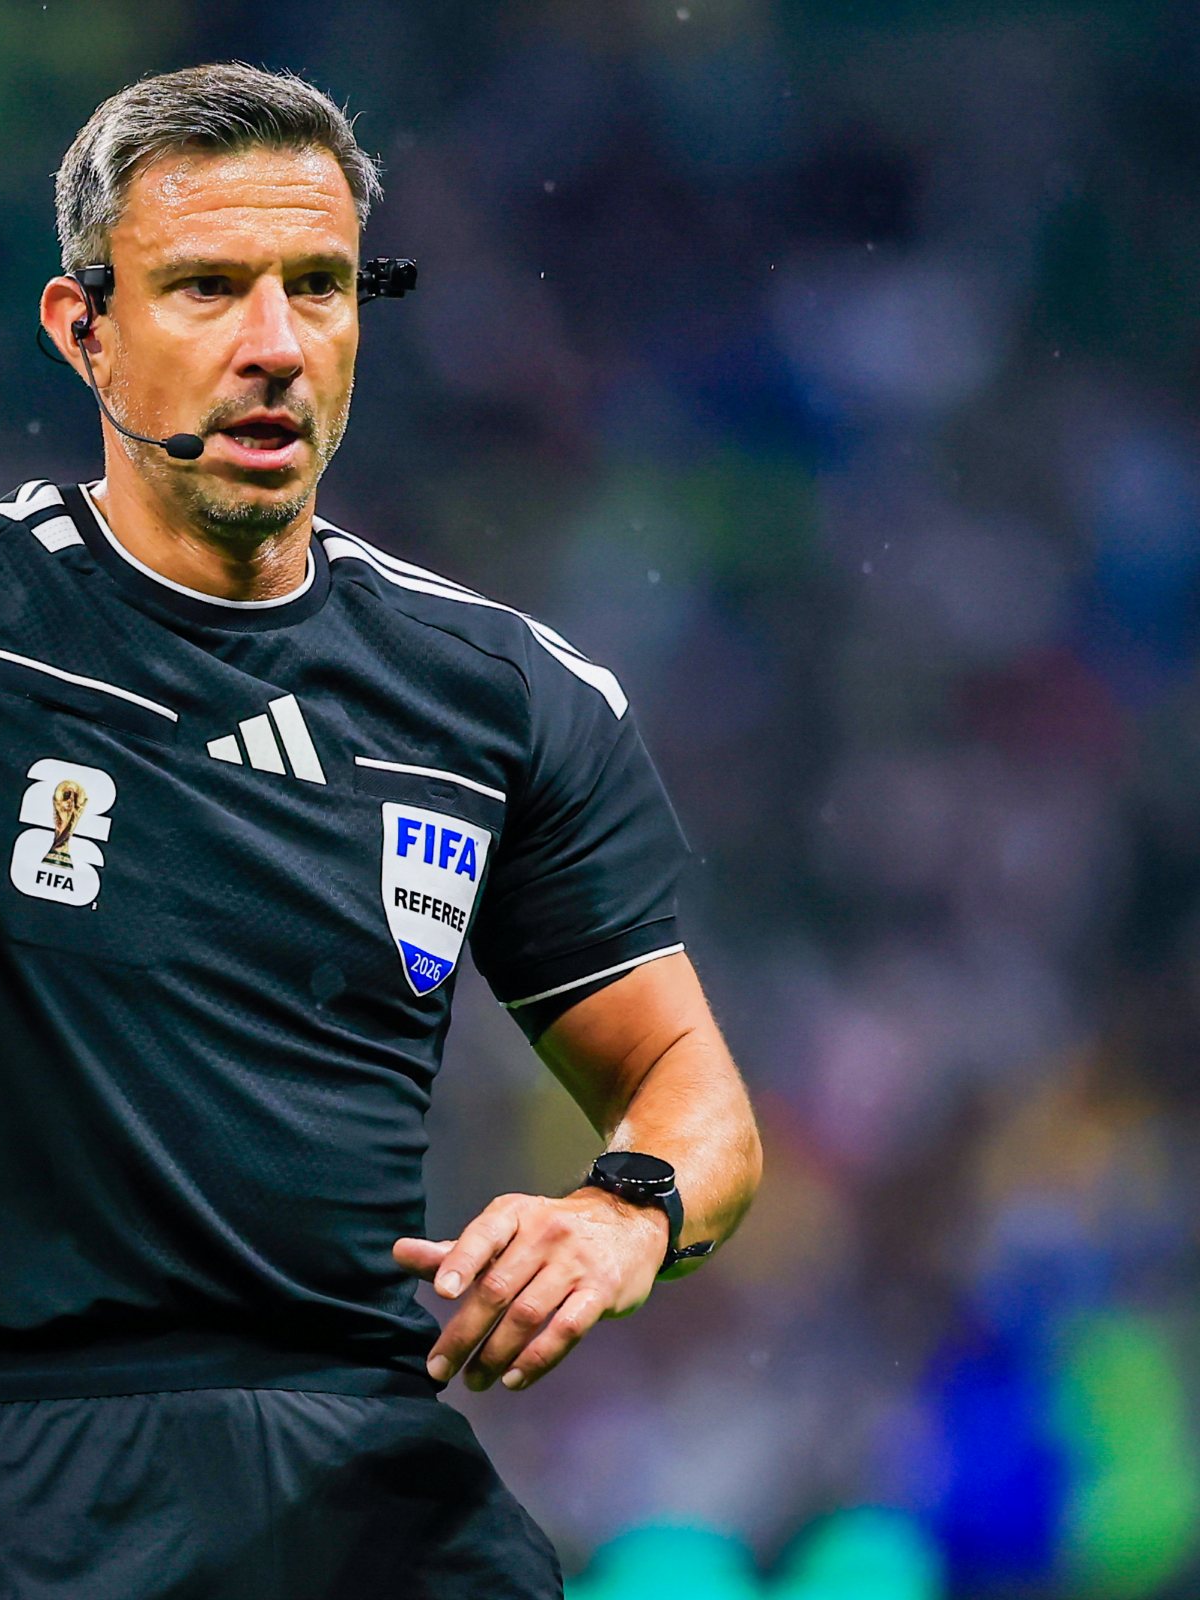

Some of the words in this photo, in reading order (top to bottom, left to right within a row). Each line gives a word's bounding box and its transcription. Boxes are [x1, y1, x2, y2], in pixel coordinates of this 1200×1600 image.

[396, 817, 477, 882] FIFA
[35, 870, 75, 892] FIFA
[394, 887, 466, 932] REFEREE
[411, 953, 442, 981] 2026
